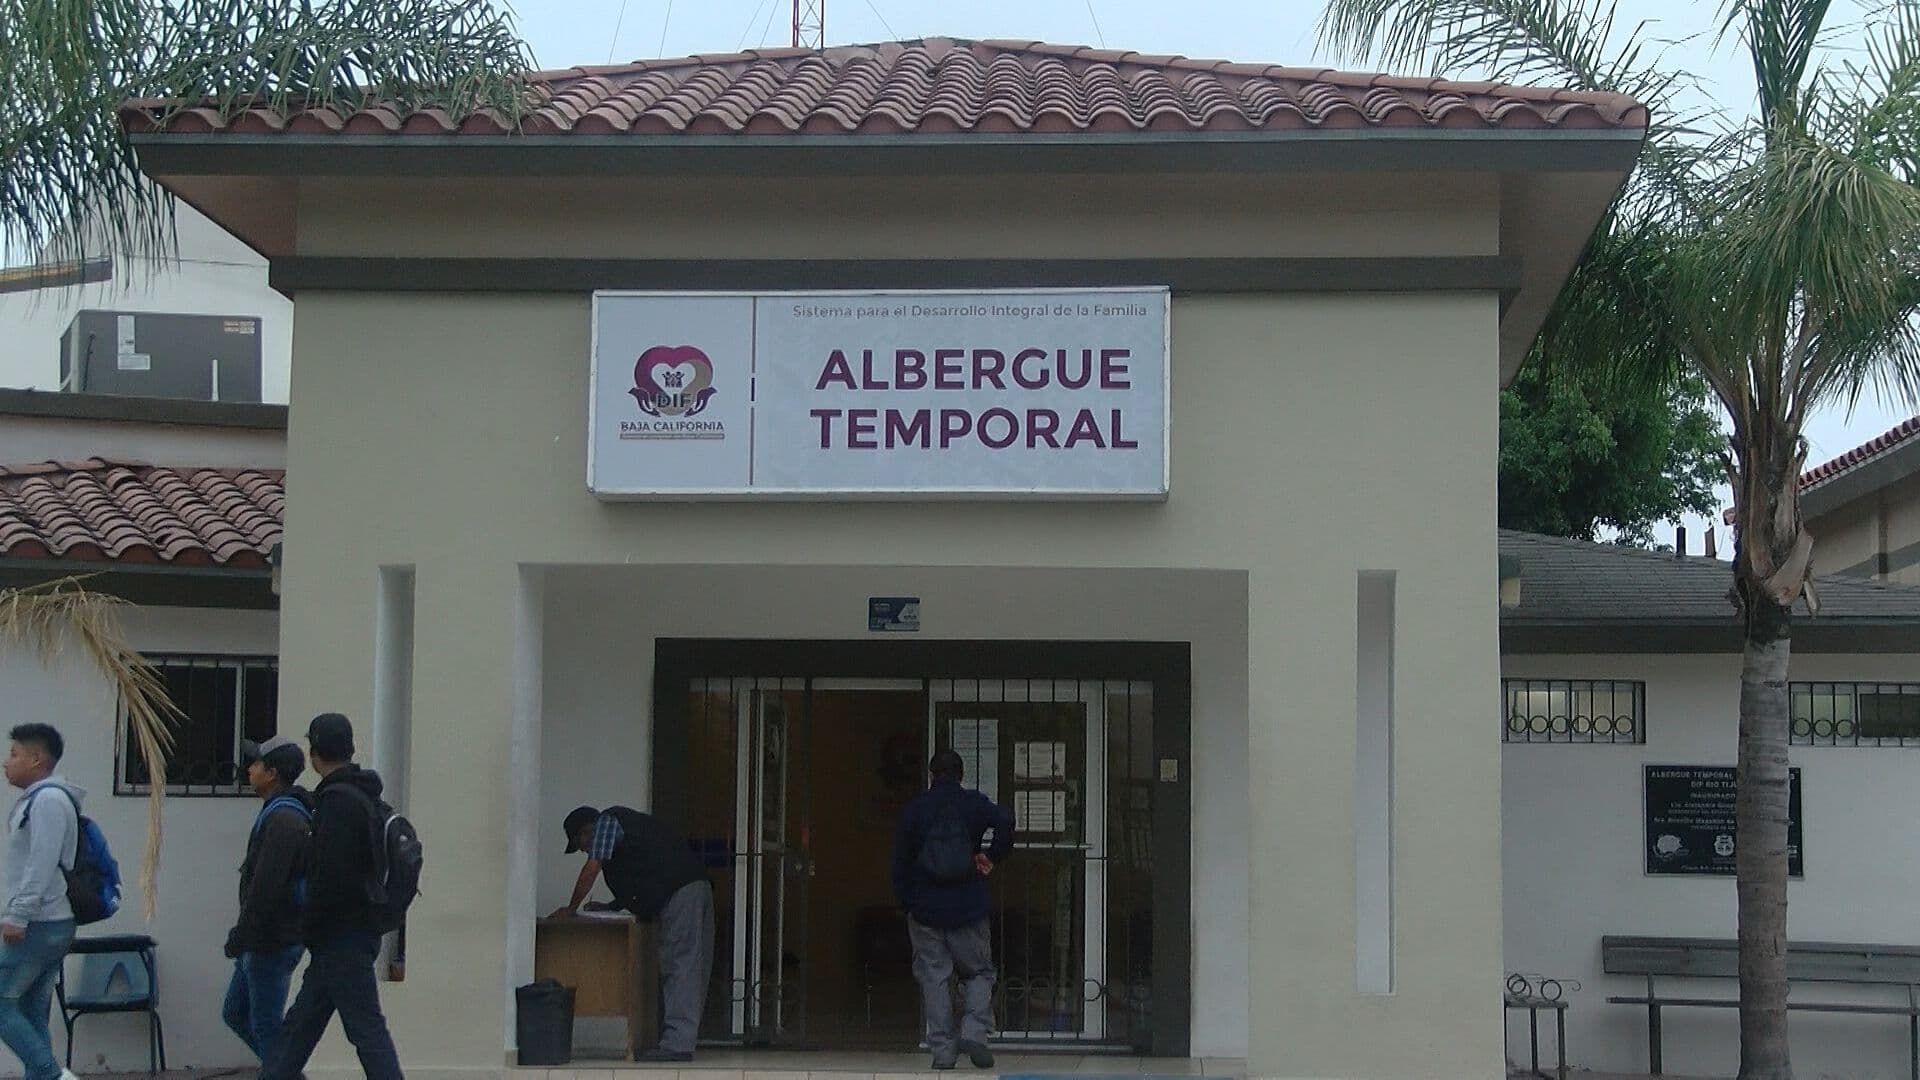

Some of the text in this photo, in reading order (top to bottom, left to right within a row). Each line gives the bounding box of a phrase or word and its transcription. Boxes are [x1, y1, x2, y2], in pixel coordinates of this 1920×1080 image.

[792, 303, 1148, 320] Sistema para el Desarrollo Integral de la Familia
[815, 348, 1132, 391] ALBERGUE
[657, 393, 692, 408] DIF
[620, 421, 724, 432] BAJA CALIFORNIA
[810, 407, 1138, 449] TEMPORAL
